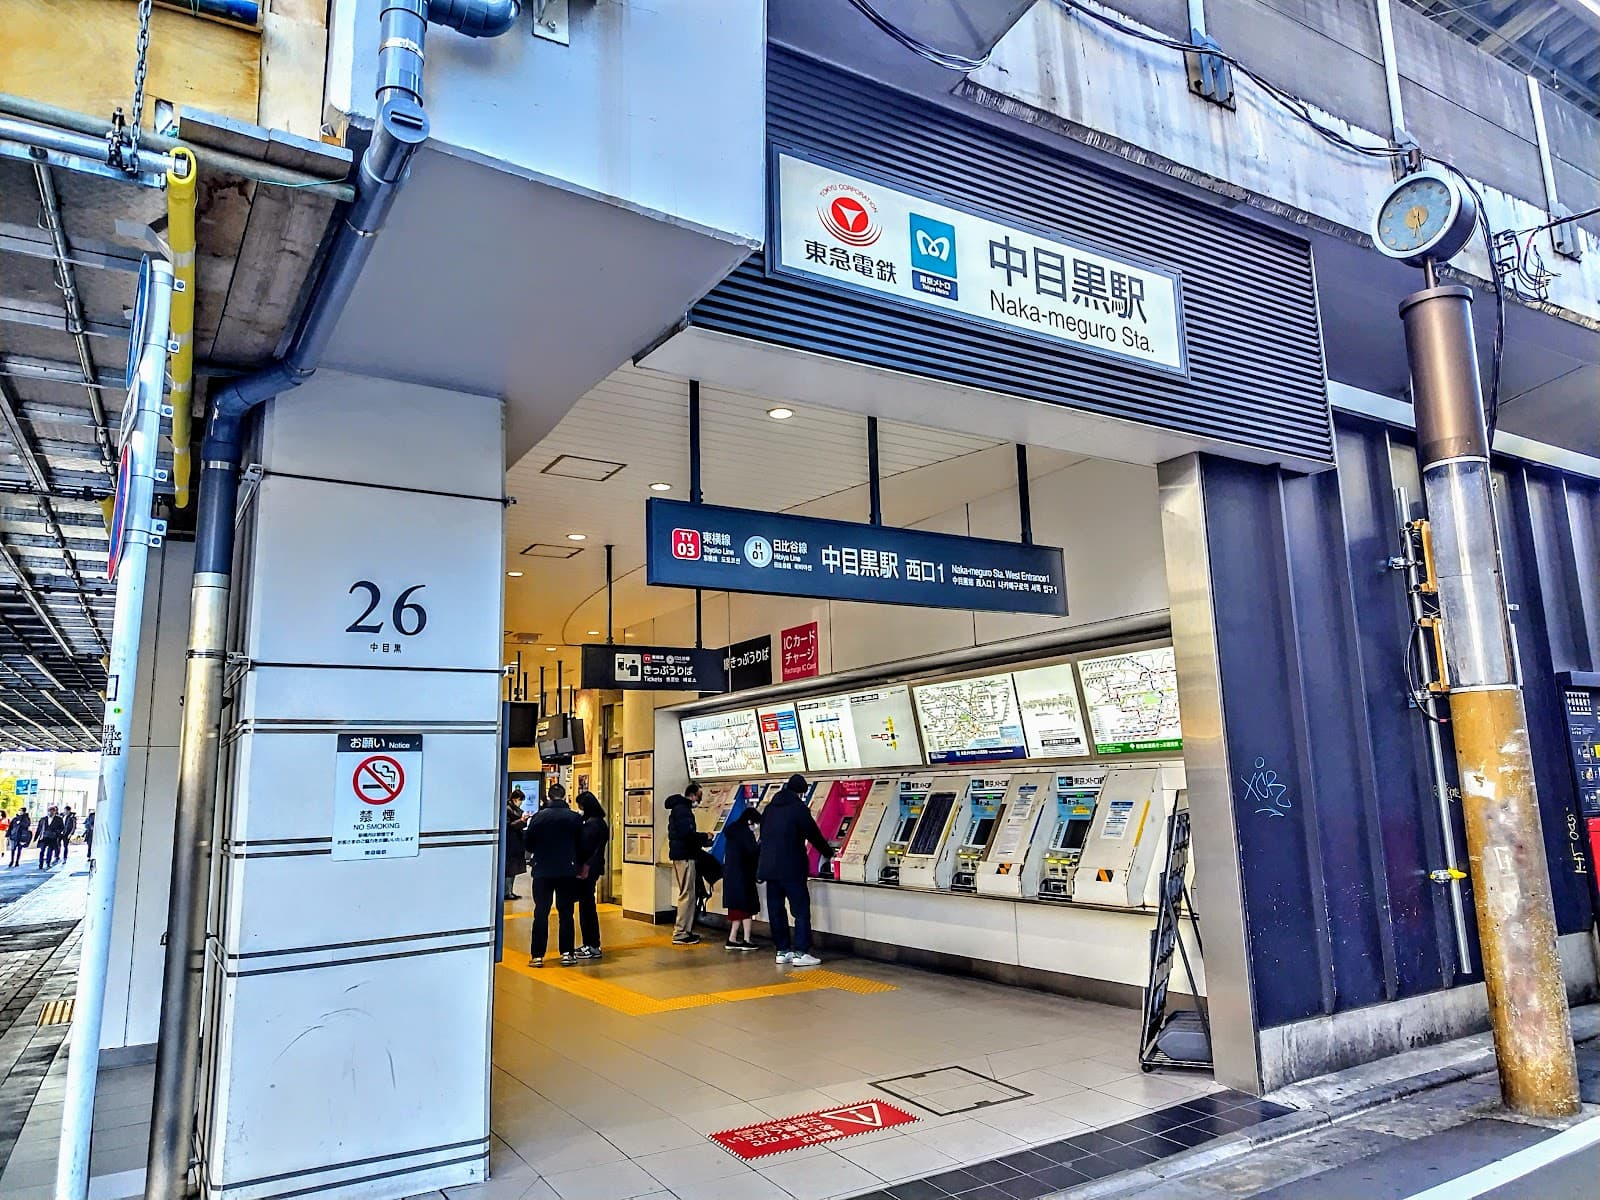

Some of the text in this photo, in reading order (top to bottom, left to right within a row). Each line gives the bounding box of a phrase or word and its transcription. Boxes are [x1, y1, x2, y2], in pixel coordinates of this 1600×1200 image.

[804, 239, 897, 284] 東急電鉄
[920, 274, 951, 290] 東京メトロ
[989, 235, 1147, 324] 中目黒駅
[990, 289, 1155, 353] Naka-meguro Sta.
[680, 532, 692, 541] TY
[703, 531, 731, 546] 東横線
[677, 543, 694, 557] 03
[773, 539, 807, 554] 日比谷線
[752, 551, 764, 560] 01
[821, 545, 899, 579] 中目黒駅
[951, 564, 992, 578] Naka-meguro
[1005, 570, 1020, 580] West
[345, 580, 427, 636] 26
[370, 642, 401, 653] 中目黒
[784, 630, 815, 650] ICカード
[785, 646, 815, 665] チャージ
[643, 665, 693, 676] きっぷうりば
[350, 737, 385, 749] お願い
[366, 822, 400, 830] SMOKING
